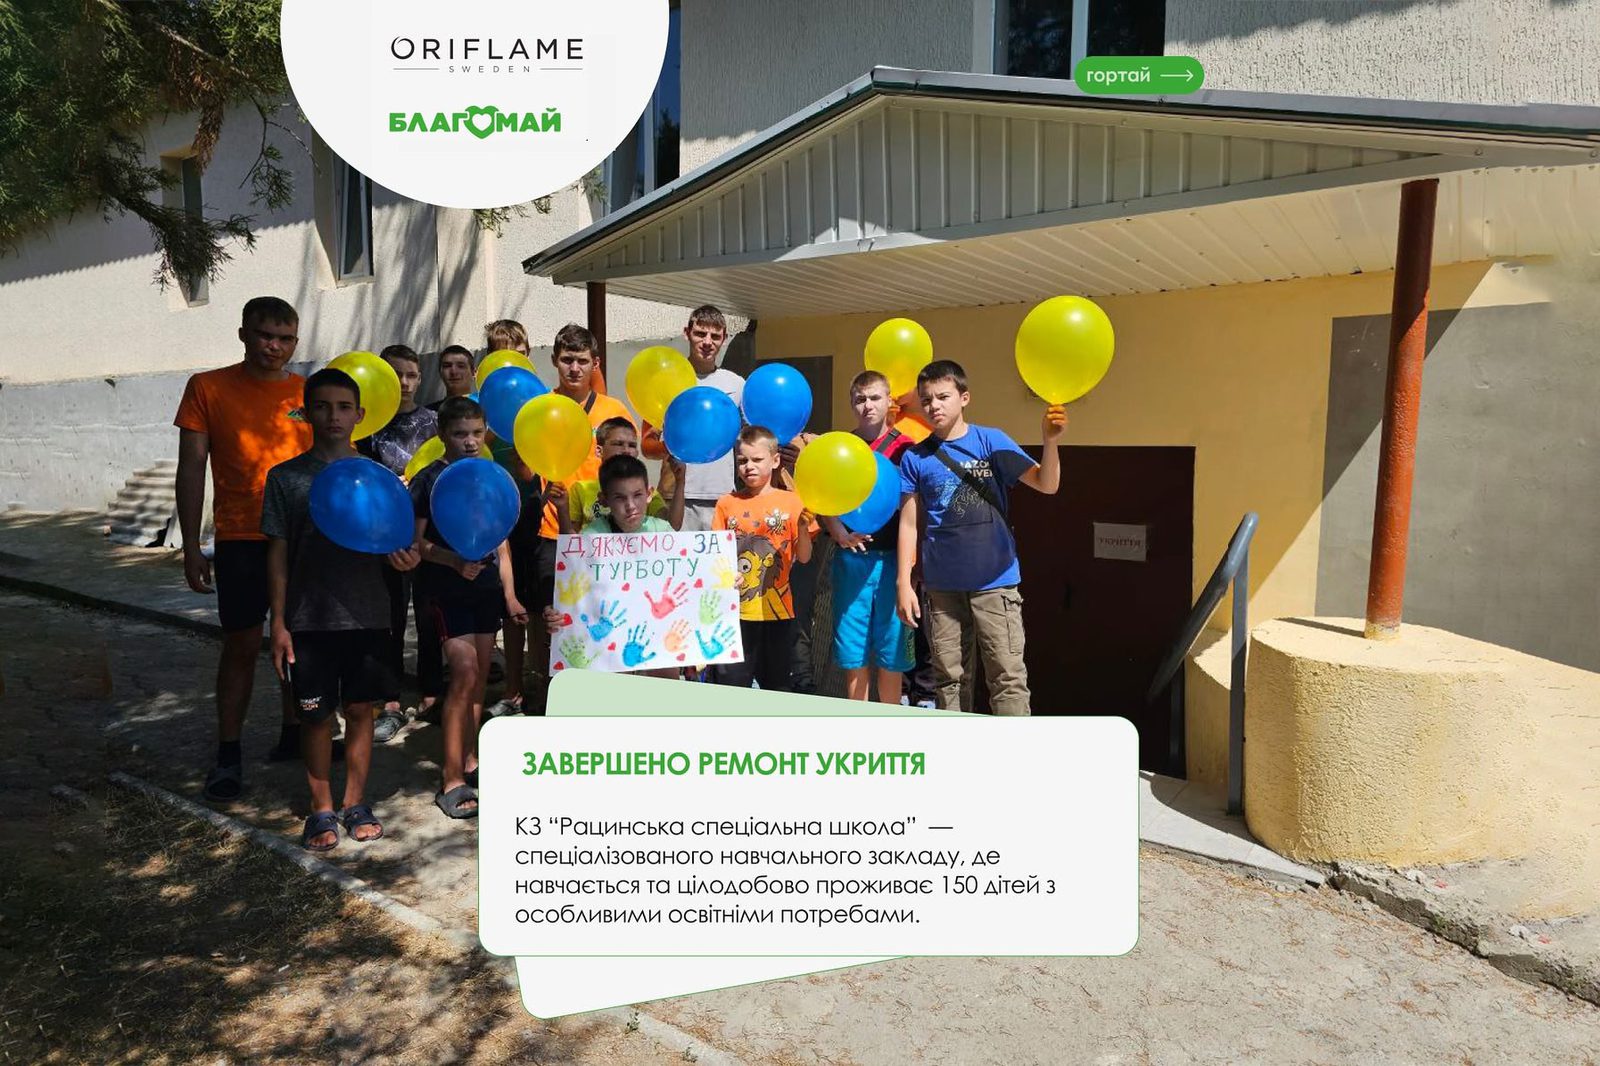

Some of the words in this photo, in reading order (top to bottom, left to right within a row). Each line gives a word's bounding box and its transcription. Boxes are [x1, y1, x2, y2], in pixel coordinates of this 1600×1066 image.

[562, 534, 675, 559] ДЯКУЄМО
[693, 533, 721, 554] ЗА
[589, 557, 699, 581] ТУРБОТУ
